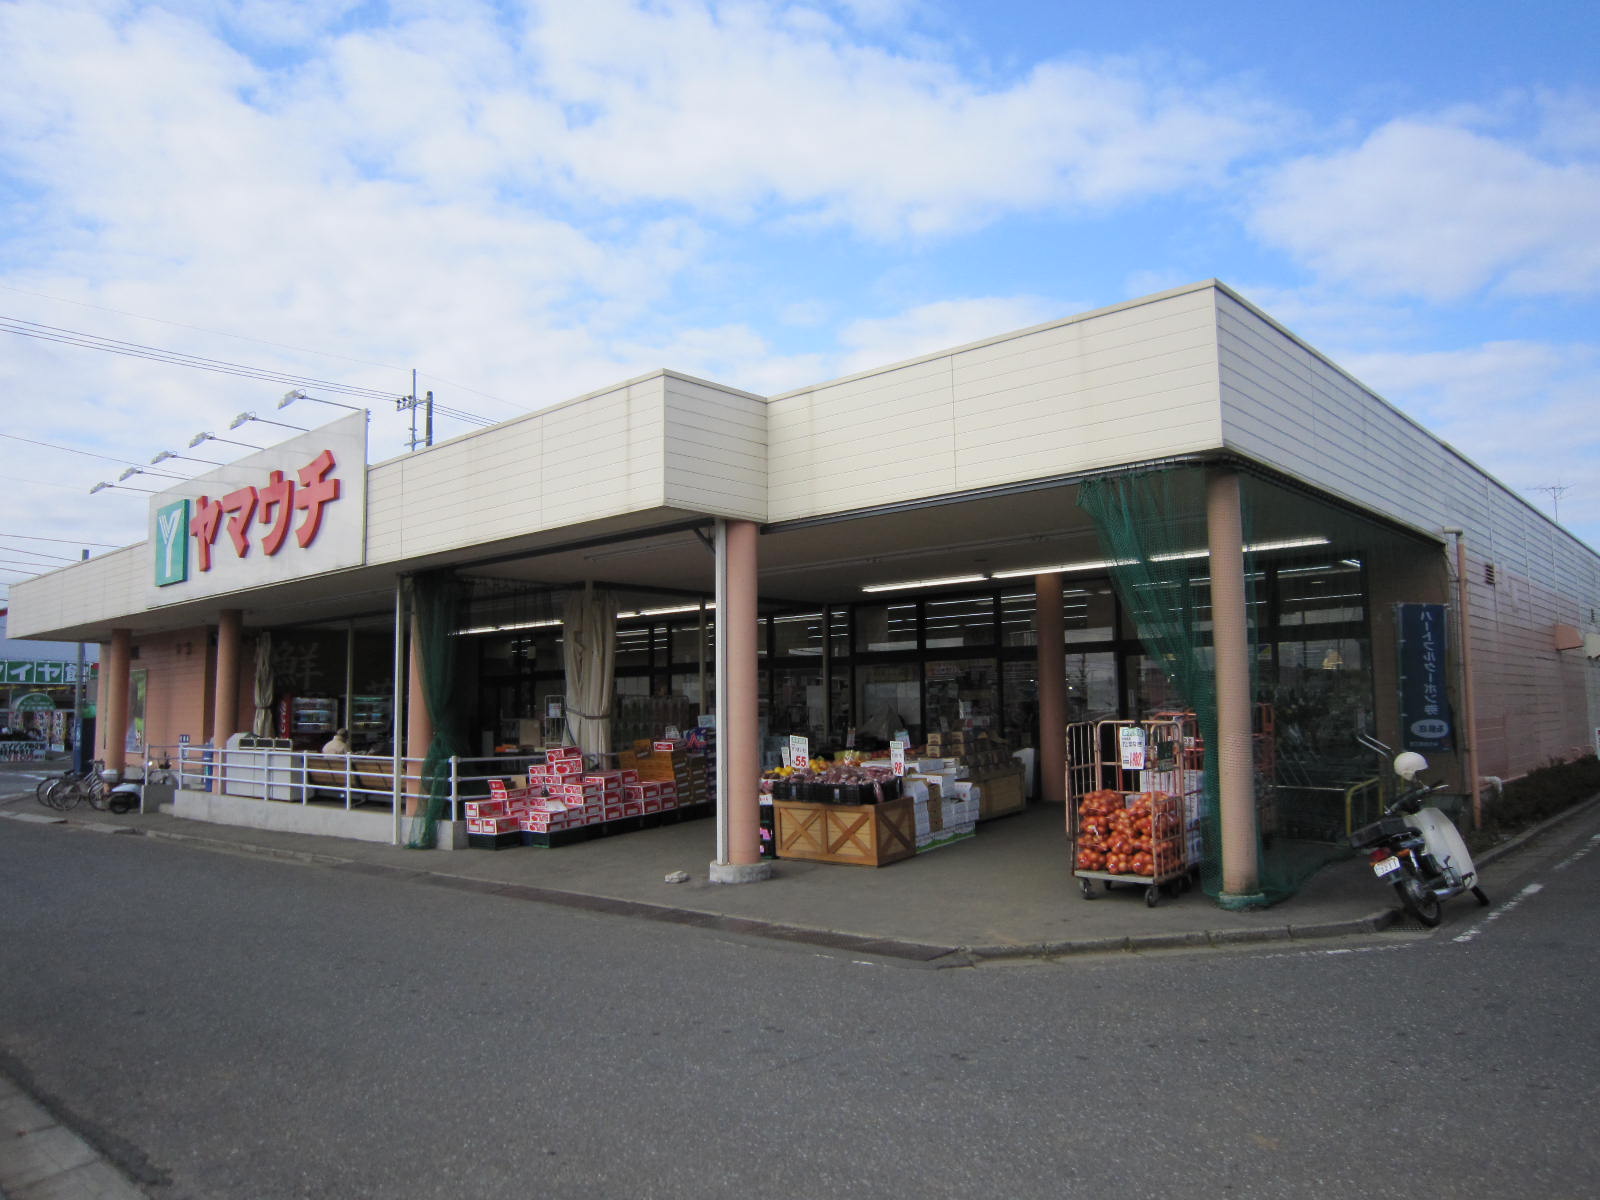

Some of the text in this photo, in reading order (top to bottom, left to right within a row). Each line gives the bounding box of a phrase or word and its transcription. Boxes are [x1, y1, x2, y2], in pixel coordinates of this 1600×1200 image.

[190, 449, 340, 572] ヤマウチ
[795, 755, 807, 767] 55
